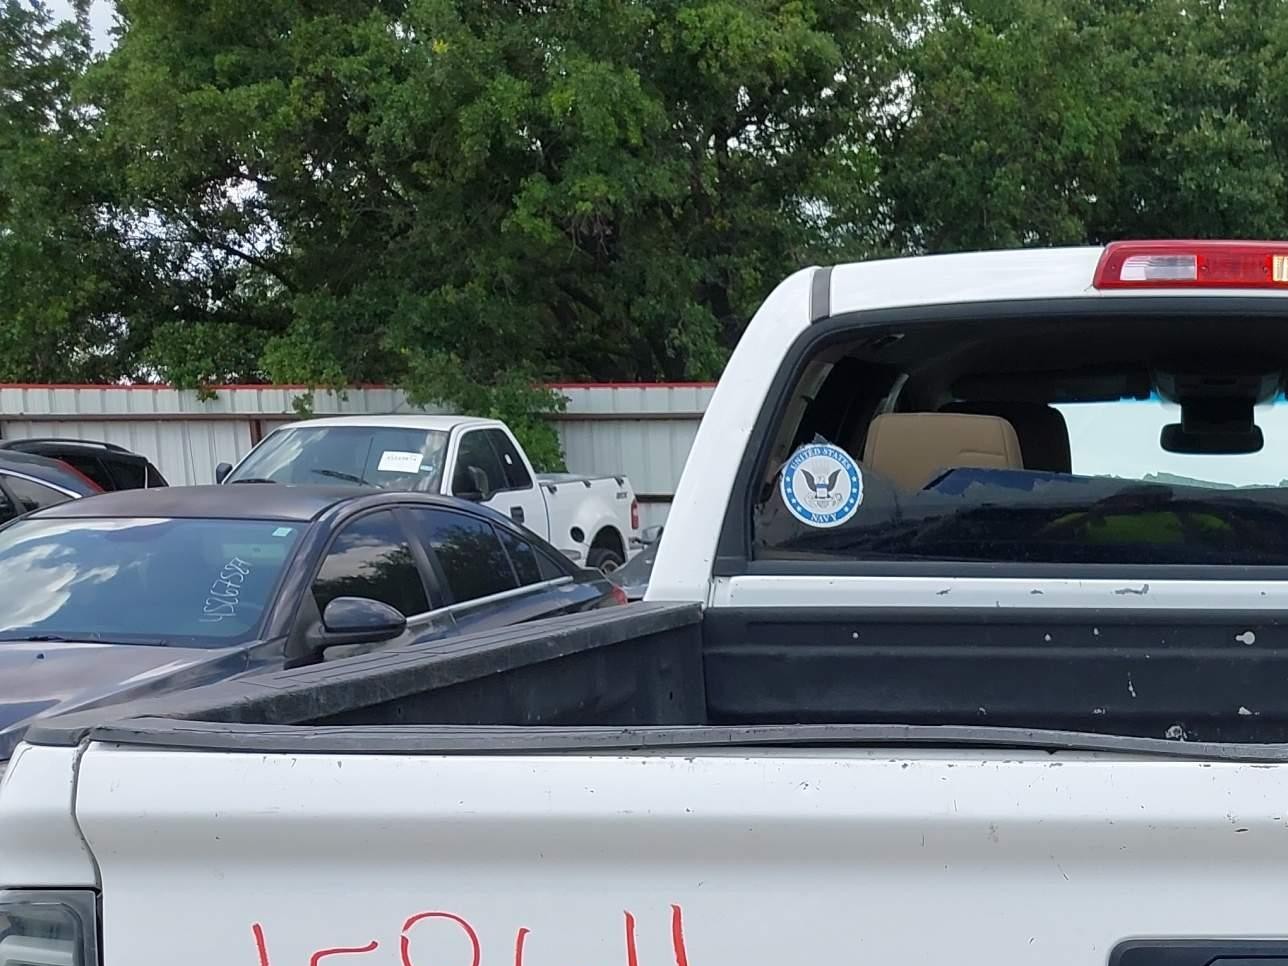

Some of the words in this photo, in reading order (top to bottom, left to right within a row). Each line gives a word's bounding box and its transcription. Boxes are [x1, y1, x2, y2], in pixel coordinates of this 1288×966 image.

[790, 446, 821, 470] UNITED
[823, 448, 851, 470] STATES
[810, 512, 838, 524] NAVY
